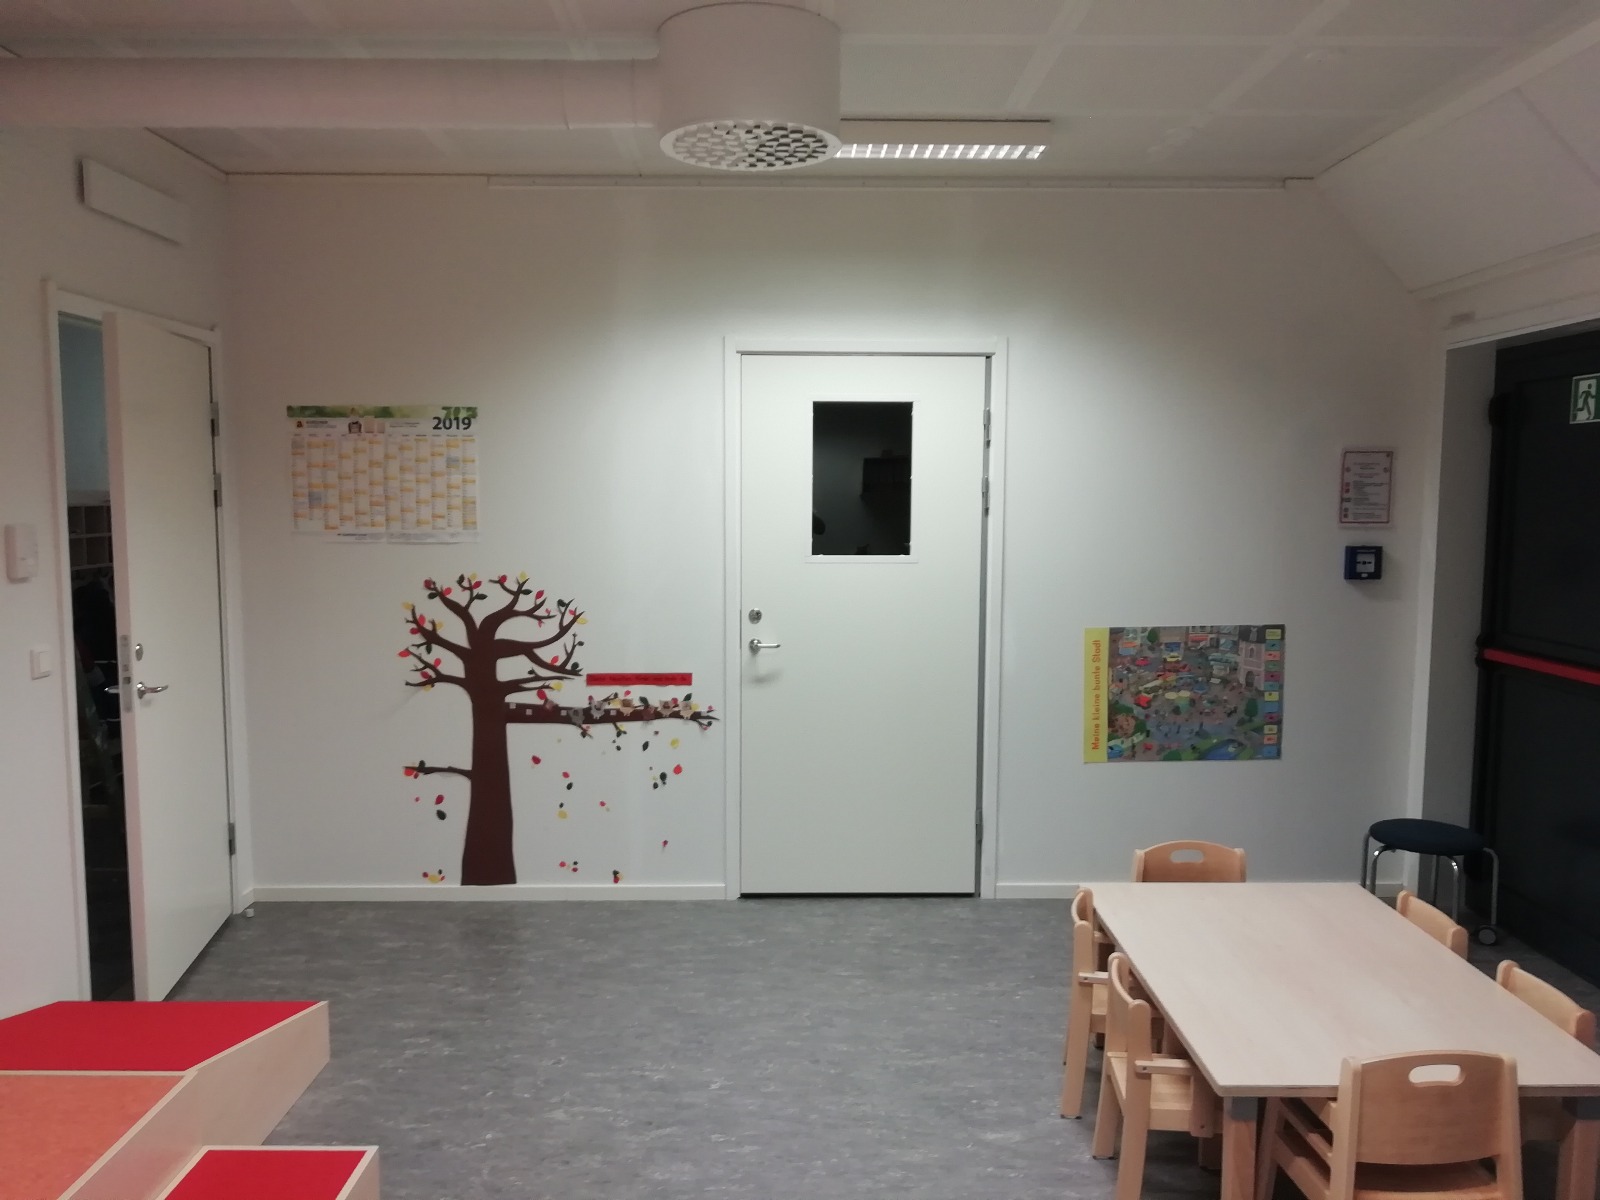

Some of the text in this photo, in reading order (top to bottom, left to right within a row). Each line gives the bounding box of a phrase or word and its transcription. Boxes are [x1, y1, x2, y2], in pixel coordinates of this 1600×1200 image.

[432, 416, 472, 430] 2019
[1092, 639, 1101, 750] Meine kleine bunte Stadt
